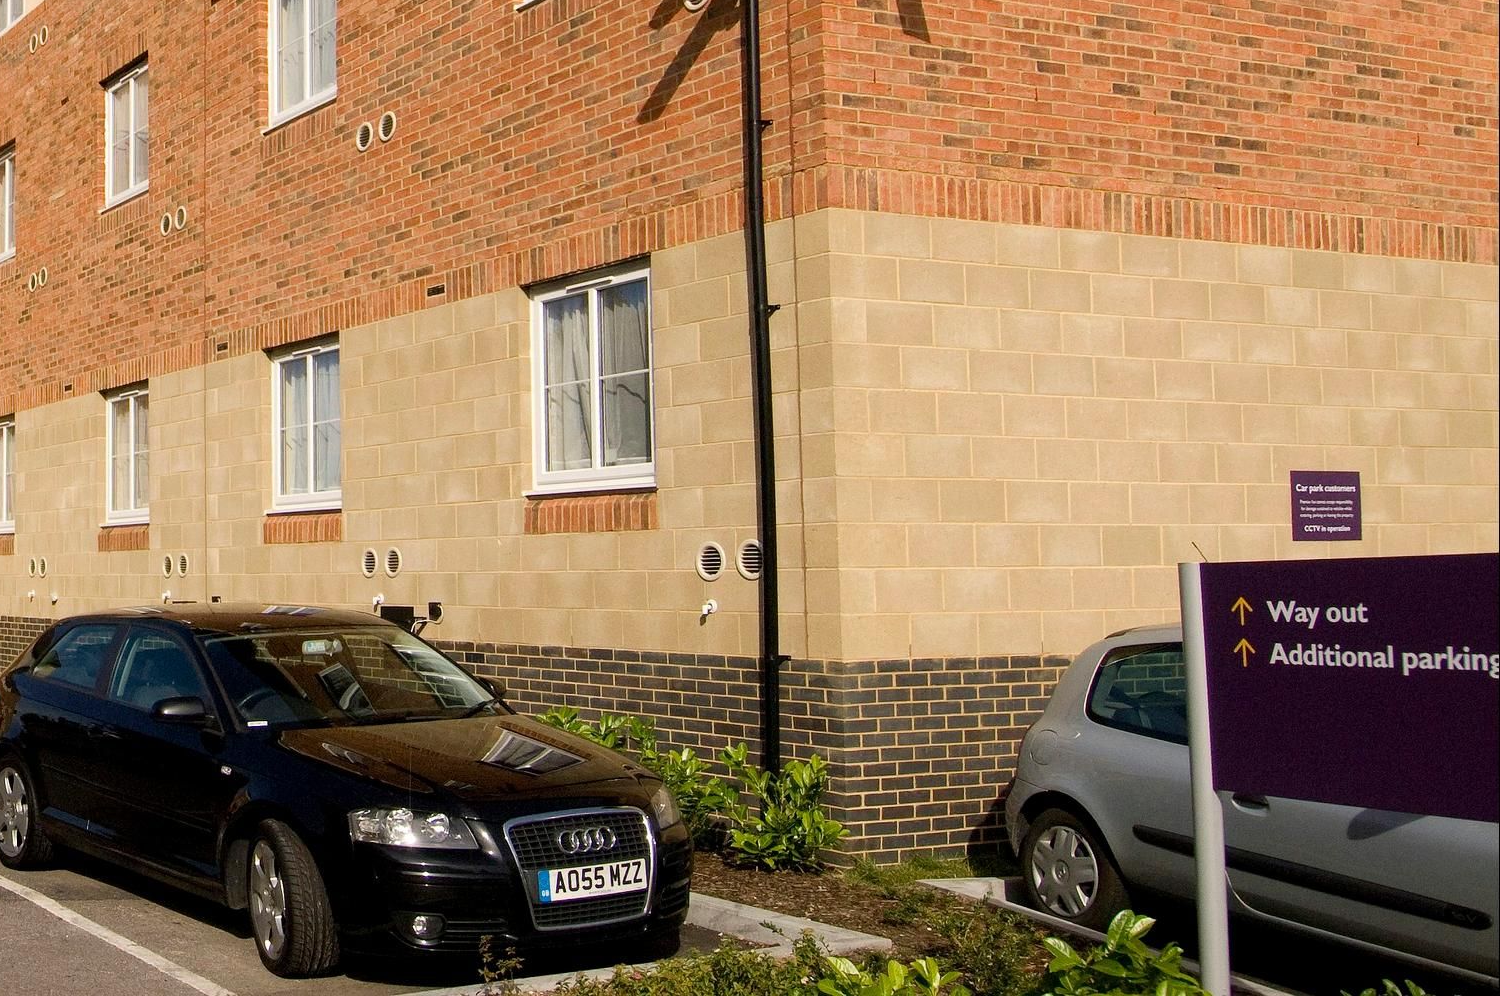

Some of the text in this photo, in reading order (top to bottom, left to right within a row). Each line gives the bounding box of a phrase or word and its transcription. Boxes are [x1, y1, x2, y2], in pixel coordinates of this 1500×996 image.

[1295, 484, 1308, 492] Car
[1309, 484, 1324, 494] park
[1266, 600, 1369, 629] Way out
[1269, 643, 1394, 668] Additional
[555, 861, 643, 894] AO55 MZZ
